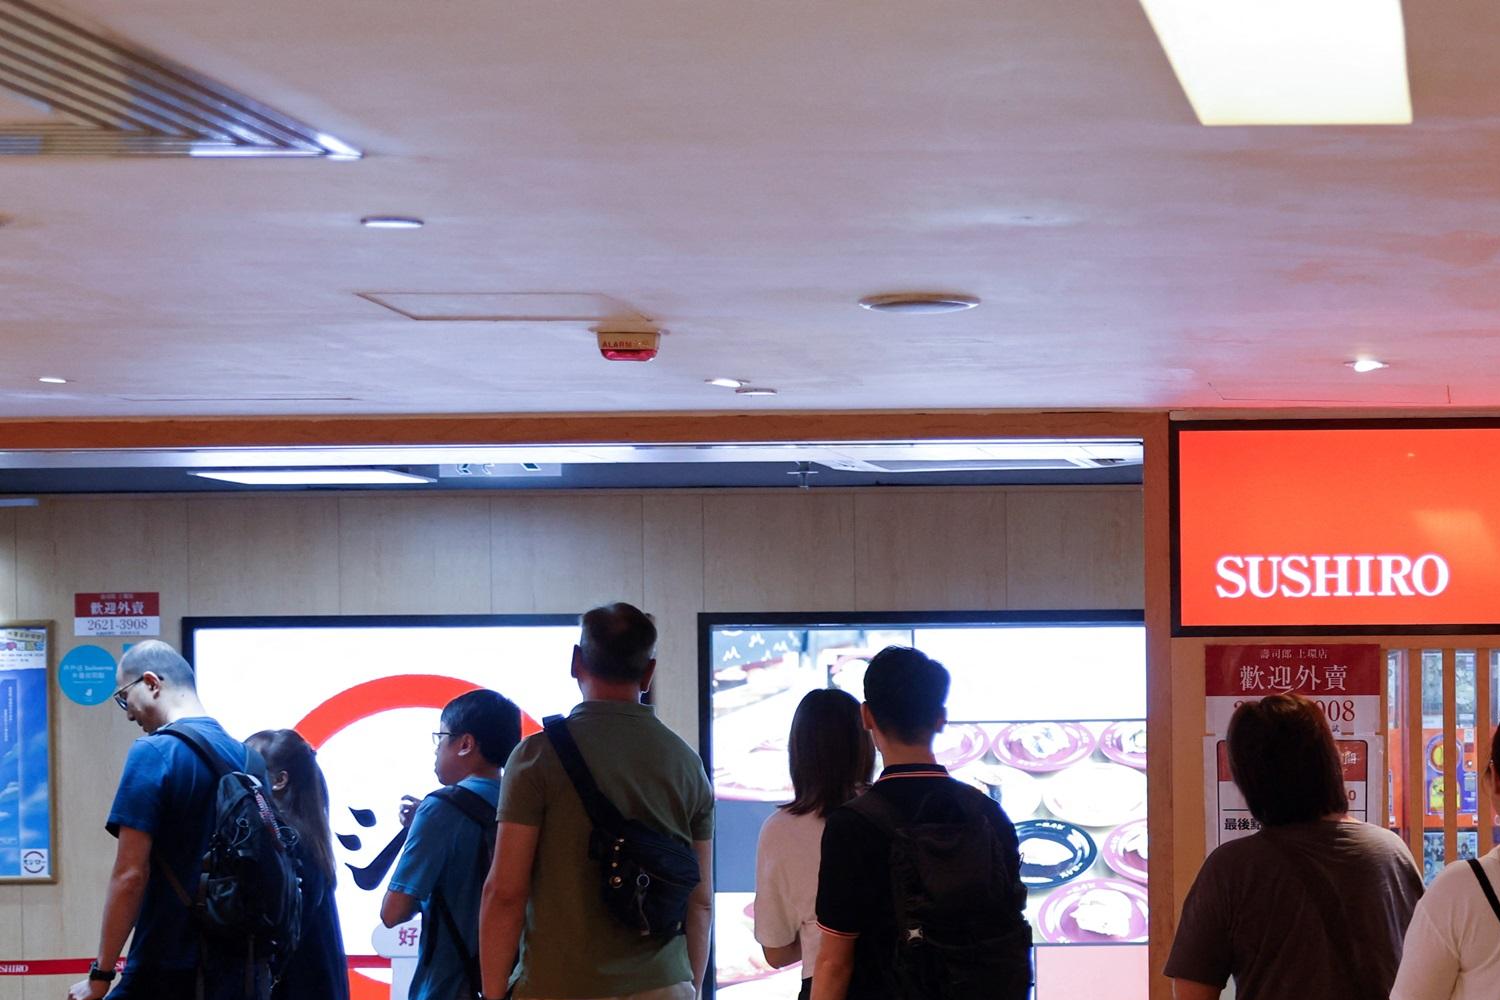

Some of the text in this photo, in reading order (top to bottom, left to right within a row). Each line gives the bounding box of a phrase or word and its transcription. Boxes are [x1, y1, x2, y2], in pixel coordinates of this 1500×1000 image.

[1214, 553, 1450, 599] SUSHIRO
[87, 618, 149, 631] 2621-3908
[1239, 664, 1349, 691] 歡迎外賣
[398, 927, 418, 947] 好
